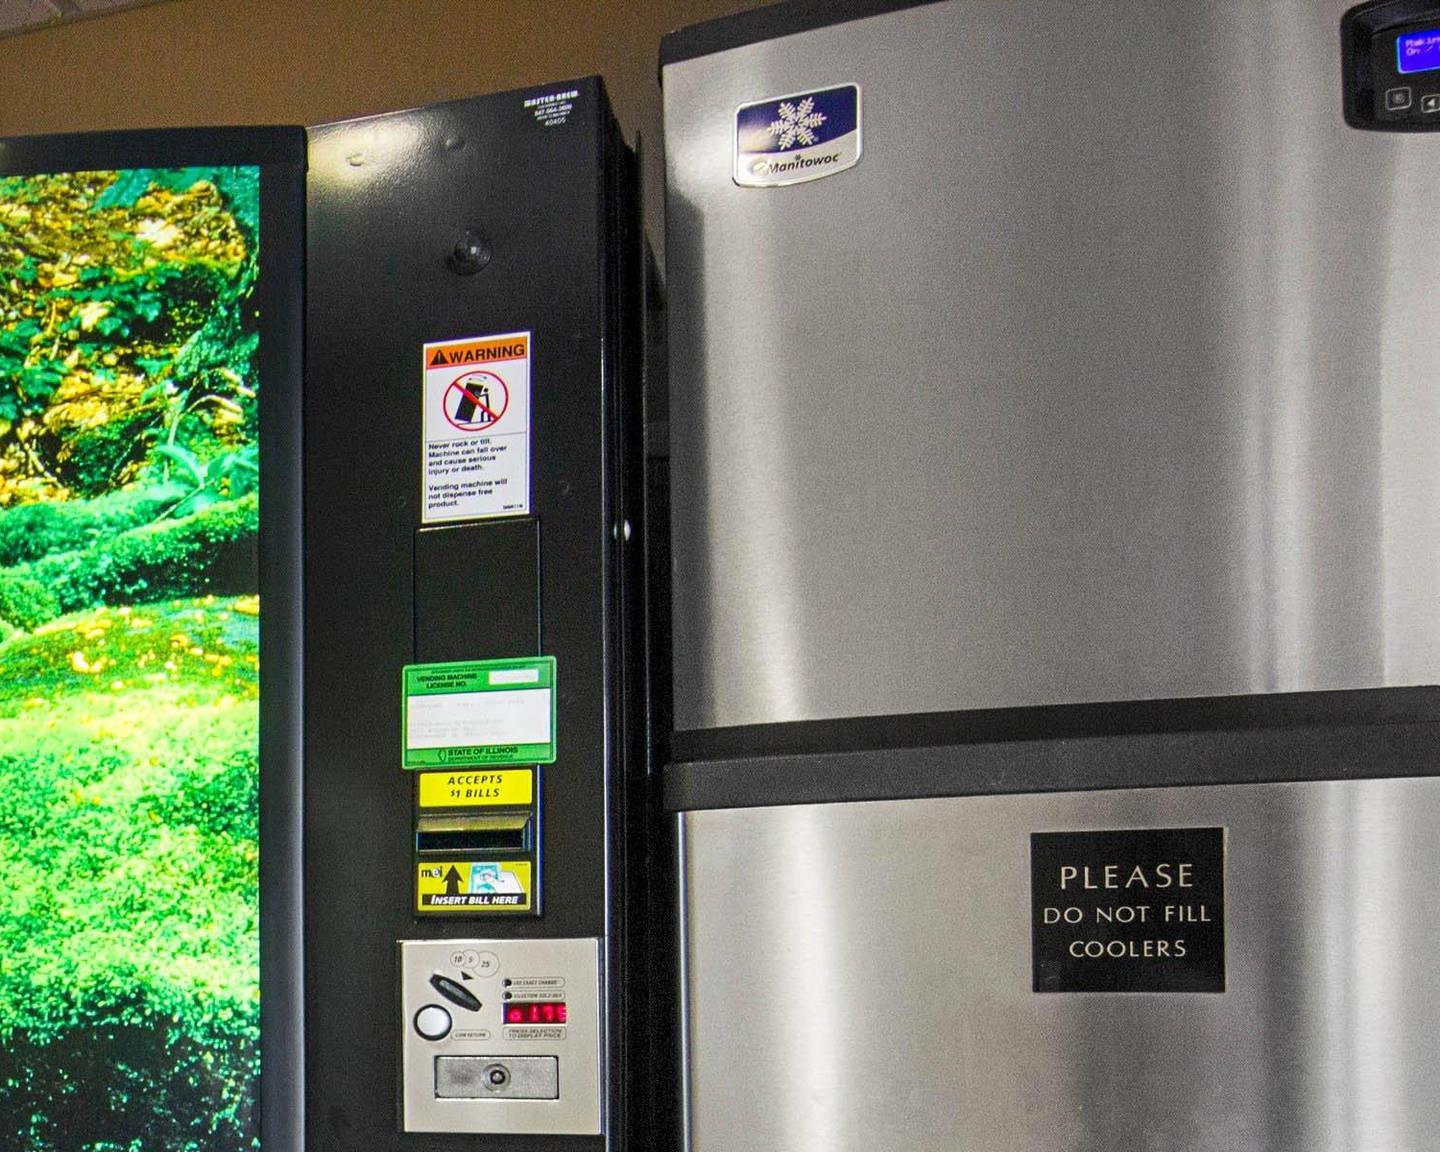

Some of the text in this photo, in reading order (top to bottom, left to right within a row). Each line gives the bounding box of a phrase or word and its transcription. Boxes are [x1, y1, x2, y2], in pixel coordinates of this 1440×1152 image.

[767, 152, 839, 175] Manitowoc
[449, 343, 525, 364] WARNING
[428, 450, 459, 458] Machine
[468, 455, 496, 463] serious
[428, 467, 449, 476] injury
[428, 483, 459, 492] Vending
[460, 480, 493, 488] machine
[428, 488, 493, 500] not dispense free
[416, 674, 446, 682] VENDING
[448, 748, 472, 756] STATE
[486, 746, 518, 754] ILLINOIS
[448, 775, 503, 785] ACCEPTS
[450, 788, 500, 799] $1 BILLS
[1061, 864, 1193, 890] PLEASE
[430, 895, 518, 905] INSERT BILL HERE
[1043, 905, 1212, 924] DO NOT FILL
[1069, 939, 1187, 958] COOLERS
